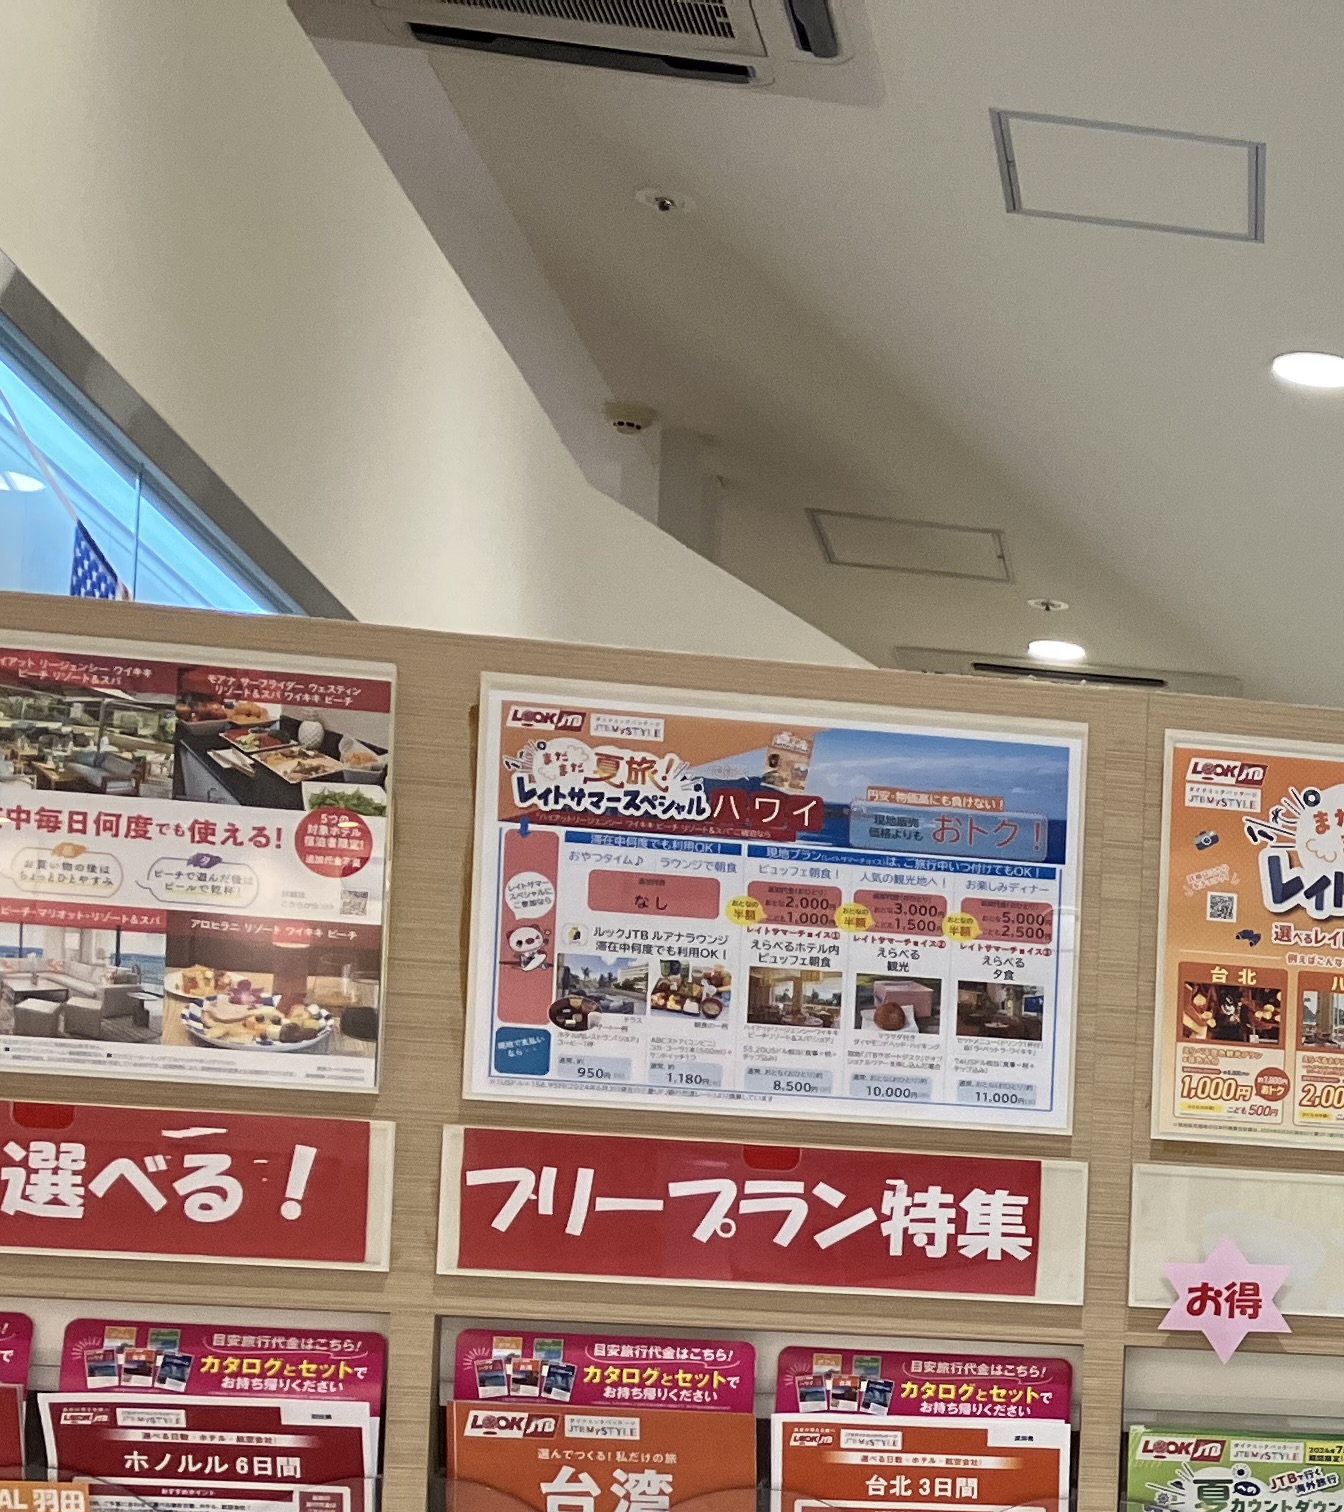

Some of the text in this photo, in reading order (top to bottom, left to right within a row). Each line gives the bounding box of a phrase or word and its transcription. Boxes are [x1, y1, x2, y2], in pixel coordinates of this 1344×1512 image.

[516, 776, 706, 817] レイトサマースペシャル
[0, 806, 283, 849] 中毎日何度でも使える!
[932, 815, 1042, 850] おトク!
[634, 894, 669, 911] なし
[465, 1165, 1034, 1263] フリープラン特集
[1185, 1281, 1263, 1321] お得
[200, 1356, 368, 1379] カタログとセットで
[124, 1451, 301, 1478] ホノルル 6日間
[33, 1489, 85, 1512] 羽田
[865, 1474, 980, 1500] 台北 3日間
